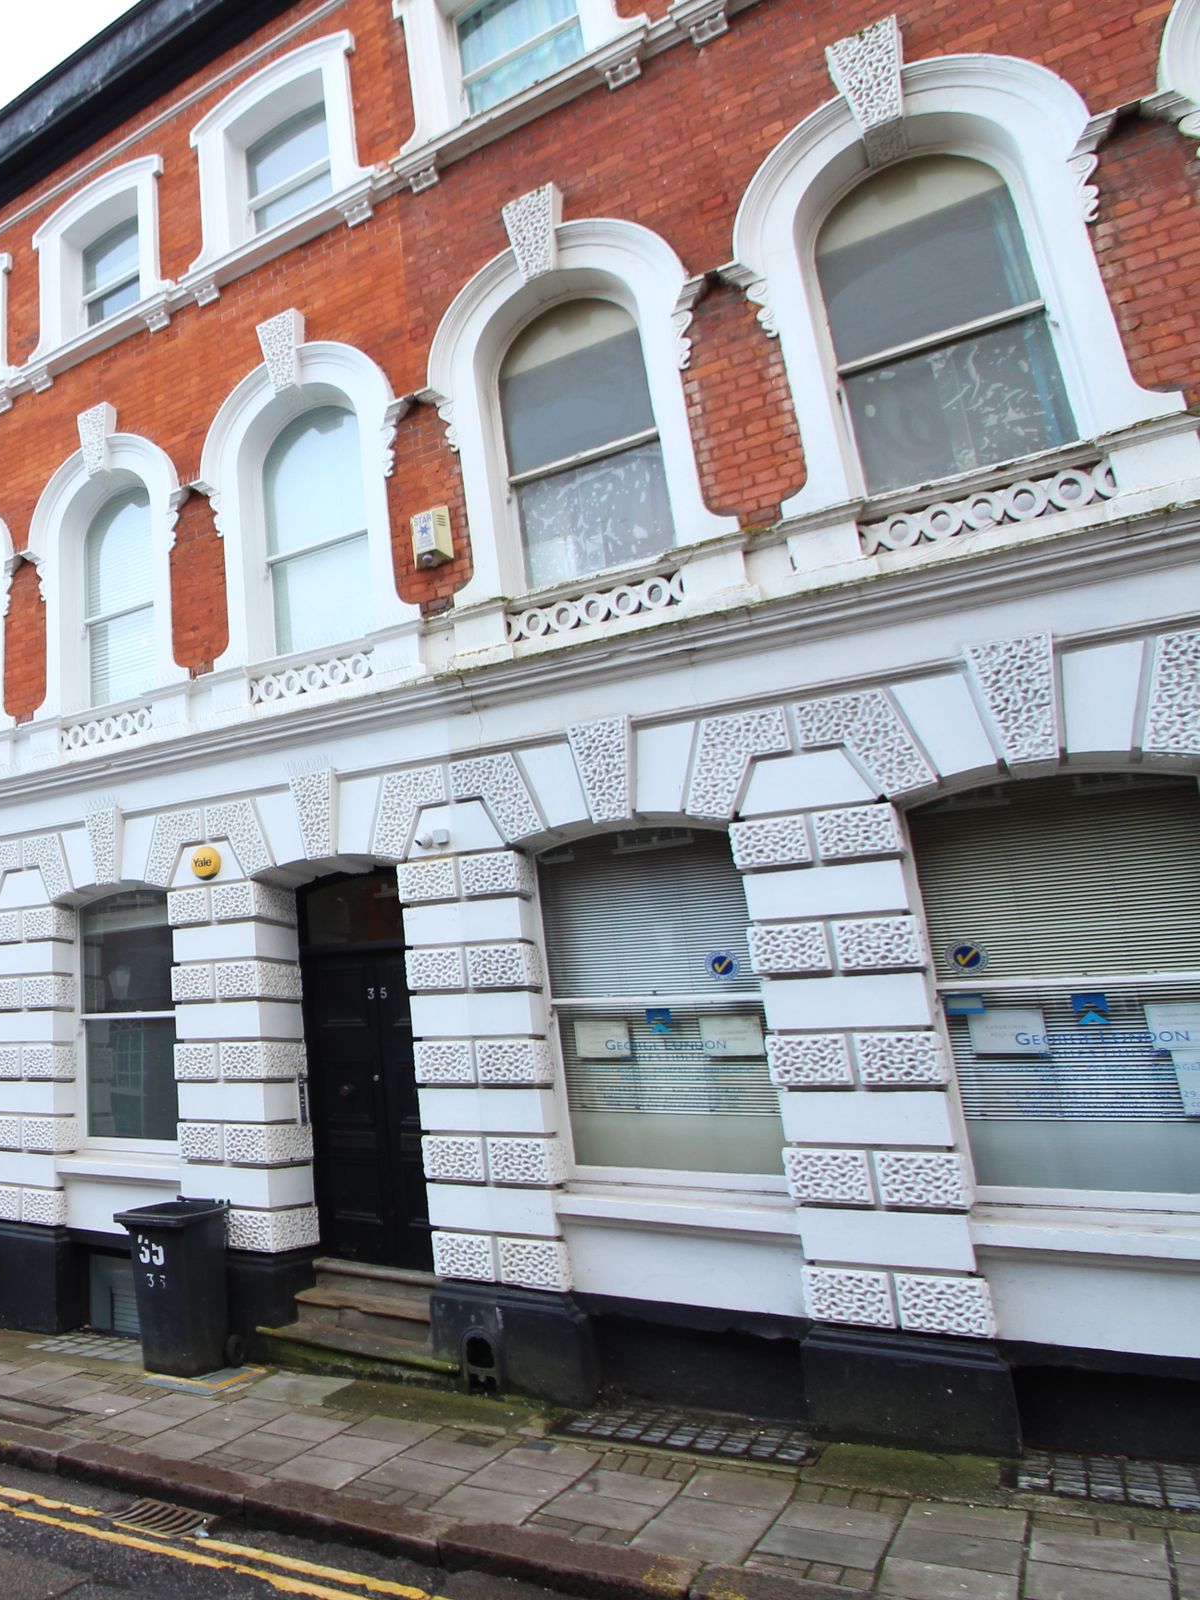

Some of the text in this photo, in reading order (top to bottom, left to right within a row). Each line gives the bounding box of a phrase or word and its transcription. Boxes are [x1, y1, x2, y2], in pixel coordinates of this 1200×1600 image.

[413, 513, 432, 526] STAR
[193, 857, 212, 868] Yale
[367, 987, 388, 1000] 35
[1098, 1029, 1190, 1044] LONDON
[664, 1038, 727, 1050] LONDON
